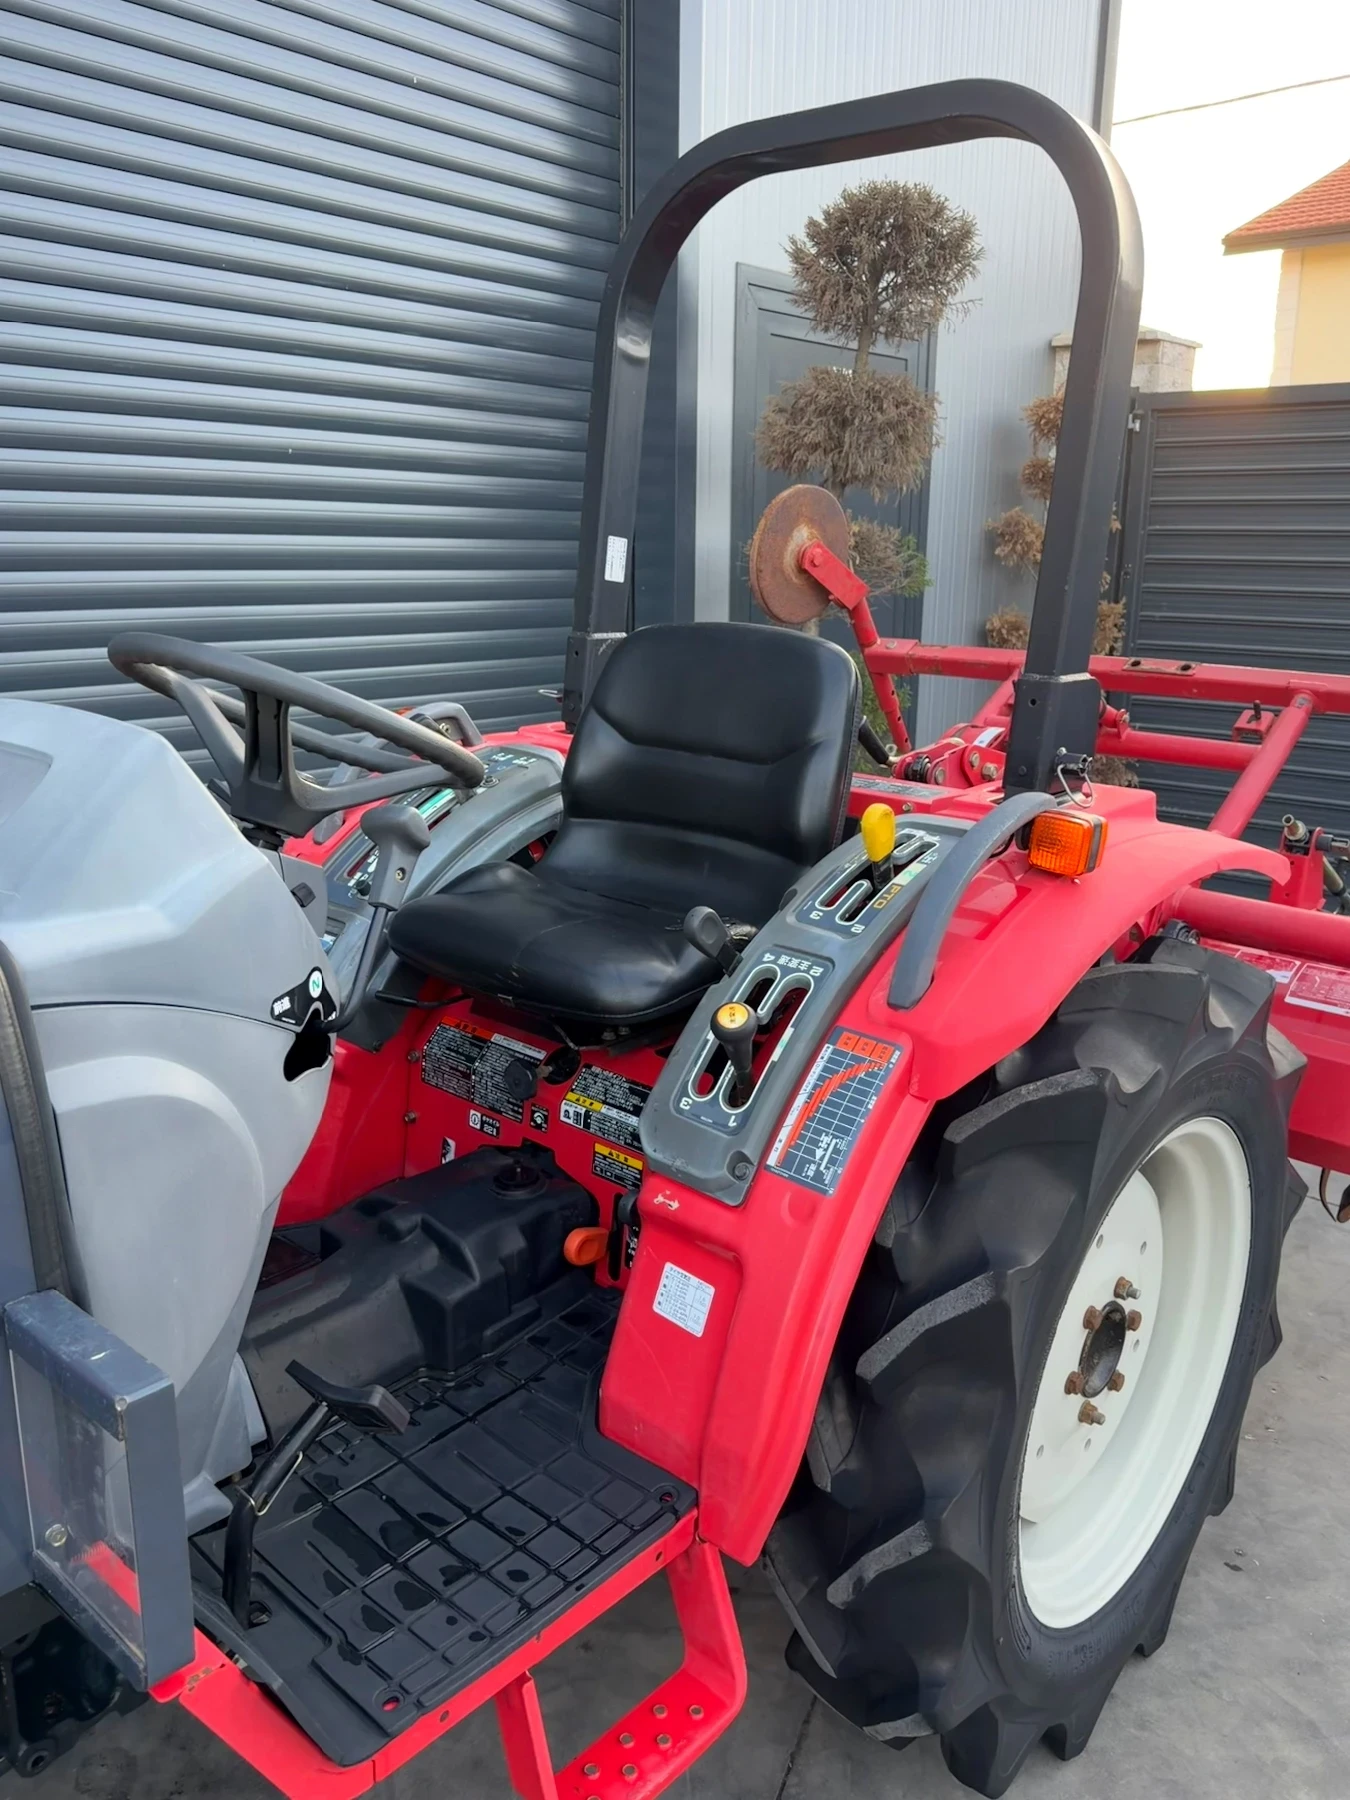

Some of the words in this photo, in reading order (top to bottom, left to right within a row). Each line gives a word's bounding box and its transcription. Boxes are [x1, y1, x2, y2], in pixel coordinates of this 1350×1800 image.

[873, 884, 902, 909] PTO
[809, 910, 824, 920] 3
[850, 923, 866, 934] 2
[762, 952, 776, 963] 4
[776, 954, 812, 971] 主変速
[809, 965, 825, 977] 2
[311, 977, 321, 993] N
[679, 1096, 693, 1110] 3
[728, 1115, 738, 1128] 1
[482, 1126, 497, 1137] 221
